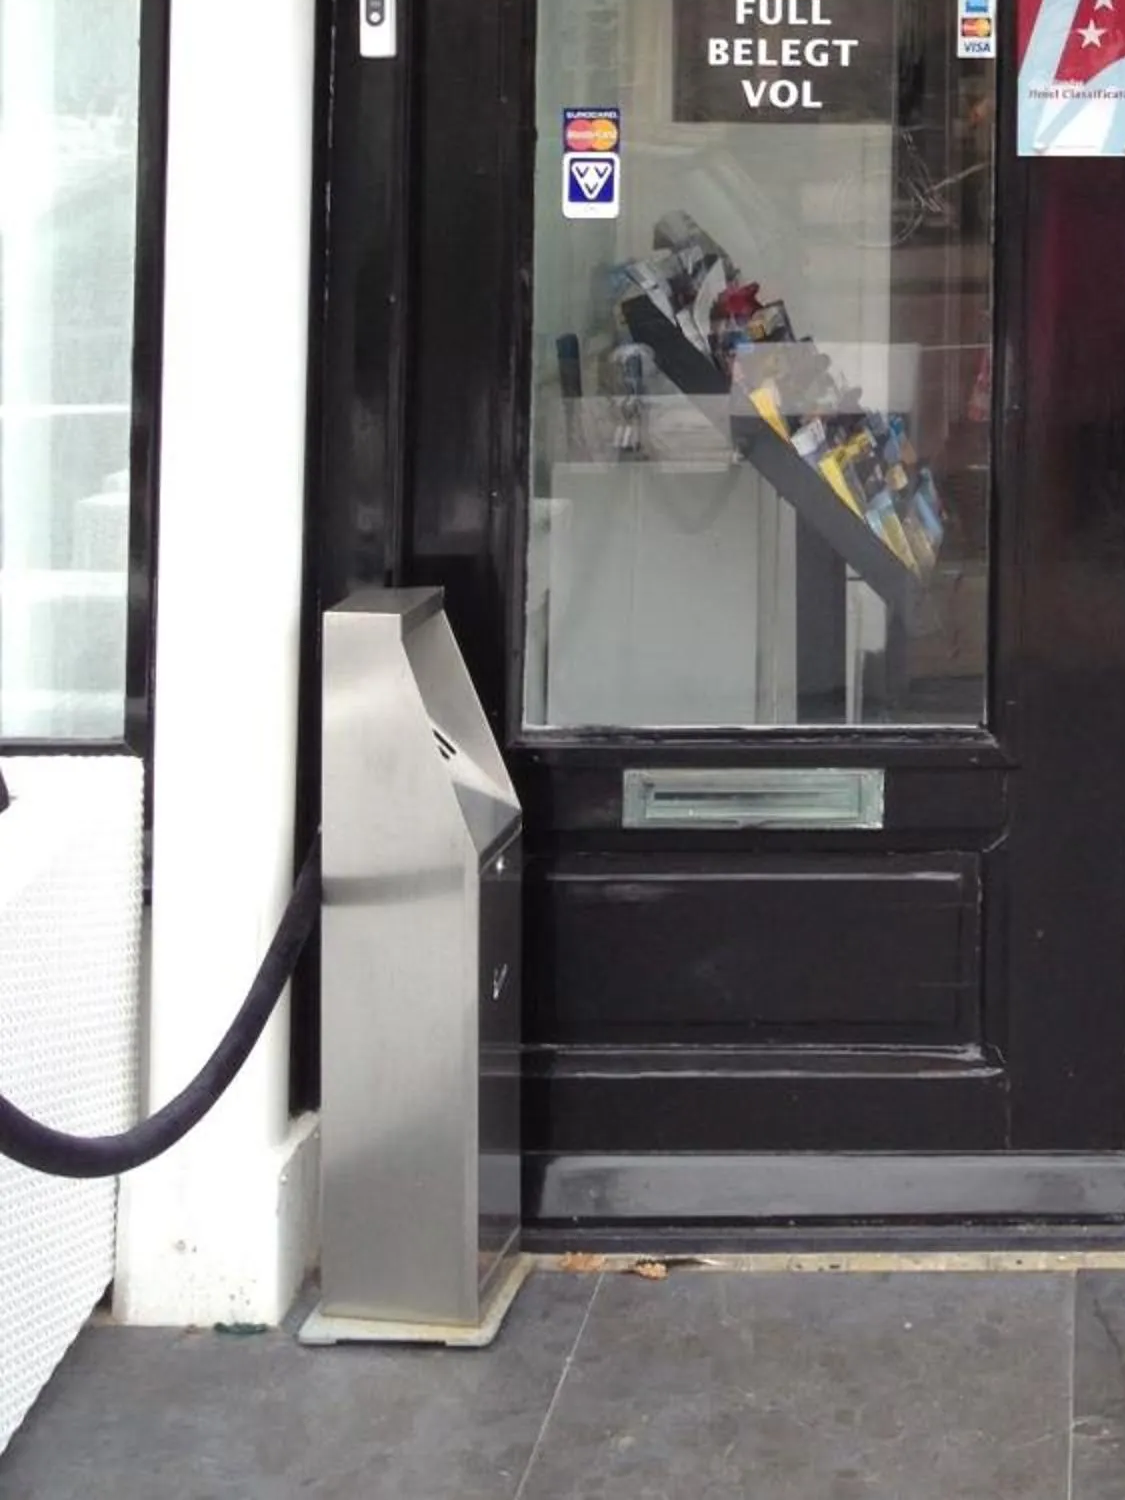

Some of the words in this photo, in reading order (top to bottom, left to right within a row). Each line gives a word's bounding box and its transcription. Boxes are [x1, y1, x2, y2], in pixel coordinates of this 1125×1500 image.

[708, 37, 859, 67] BELEGT
[964, 41, 990, 53] VISA
[741, 79, 823, 109] VOL
